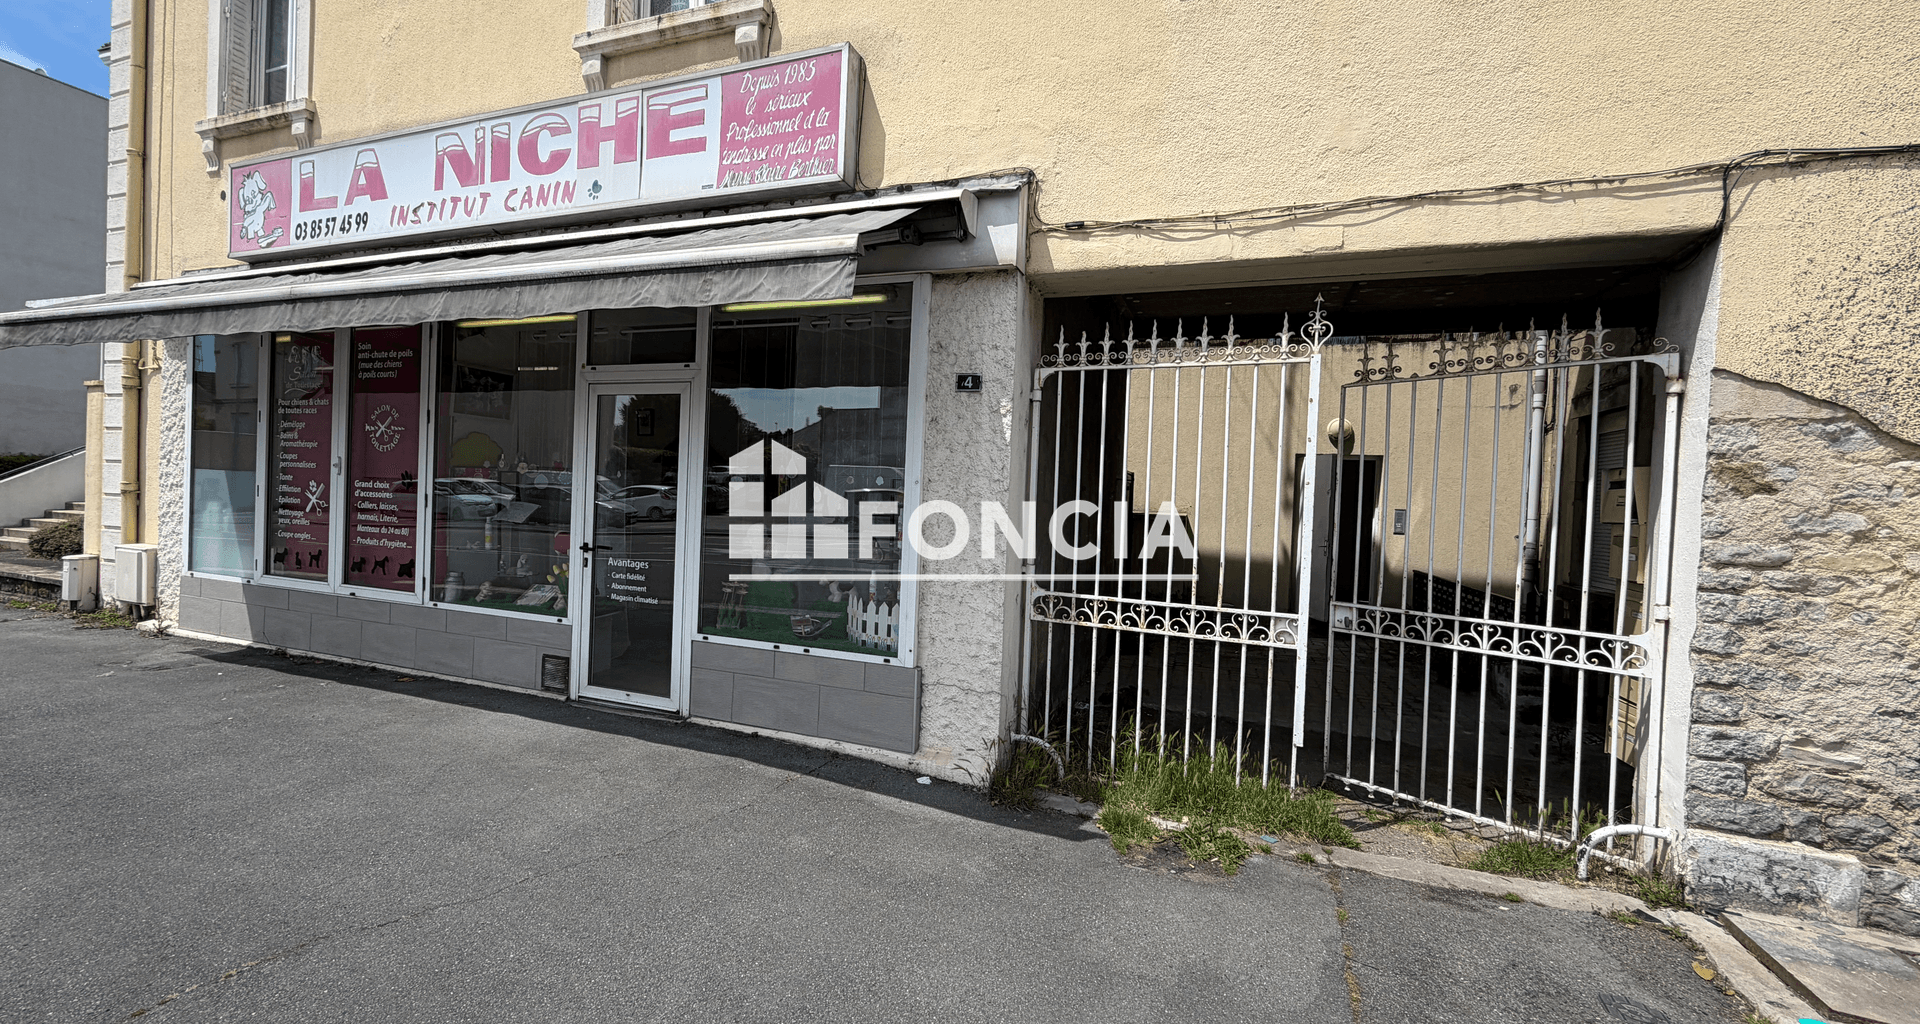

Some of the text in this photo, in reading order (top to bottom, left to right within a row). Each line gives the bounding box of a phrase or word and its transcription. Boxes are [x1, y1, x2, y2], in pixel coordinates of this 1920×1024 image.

[740, 60, 816, 97] Depuis 1985
[745, 97, 756, 115] le
[726, 107, 831, 142] Professionnel et la
[299, 84, 708, 213] LA NICHE
[771, 143, 783, 158] en
[785, 135, 811, 160] plus
[814, 133, 836, 155] par
[390, 179, 577, 228] INSTITUT CANIN
[295, 211, 368, 241] 03 85 57 45 99
[358, 342, 371, 350] Soin
[358, 350, 388, 359] anti-chute
[398, 349, 413, 359] poils
[358, 360, 402, 369] (mue des chiens
[362, 370, 376, 380] poils
[377, 370, 397, 378] courts)
[291, 398, 308, 406] chiens
[278, 406, 284, 414] de
[371, 405, 400, 421] SALON DE
[280, 440, 318, 449] Aromathérapie
[370, 432, 400, 452] TOILETTAGE
[279, 452, 298, 461] Coupes
[279, 461, 316, 469] personnalisées
[374, 480, 390, 488] choix
[355, 489, 393, 498] d'accessoires
[357, 501, 378, 510] Colliers,
[379, 502, 398, 511] laisses,
[278, 508, 304, 518] Nettoyage
[357, 512, 398, 523] harnais, Literie,
[357, 524, 380, 533] Manteaux
[278, 530, 293, 539] Coupe
[356, 536, 378, 545] Produits
[608, 557, 649, 570] Avantages
[627, 573, 645, 581] fidélité
[611, 583, 646, 592] Abonnement
[611, 593, 633, 602] Magasin
